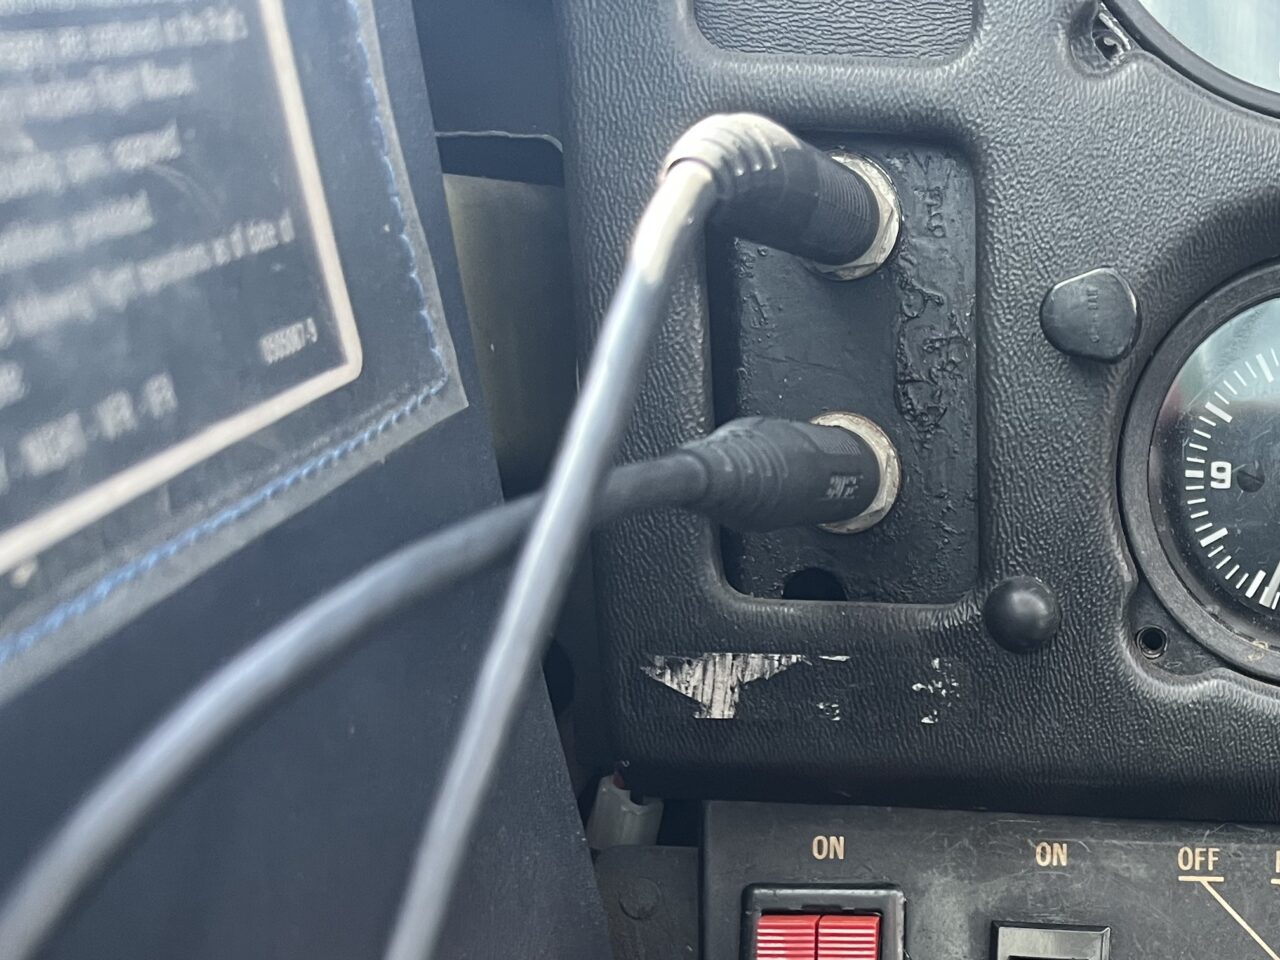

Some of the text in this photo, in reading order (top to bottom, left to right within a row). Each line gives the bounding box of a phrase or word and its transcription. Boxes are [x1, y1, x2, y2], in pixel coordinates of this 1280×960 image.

[1210, 461, 1232, 489] 9
[812, 833, 845, 860] ON
[1035, 842, 1068, 867] ON
[1177, 846, 1220, 871] OFF
